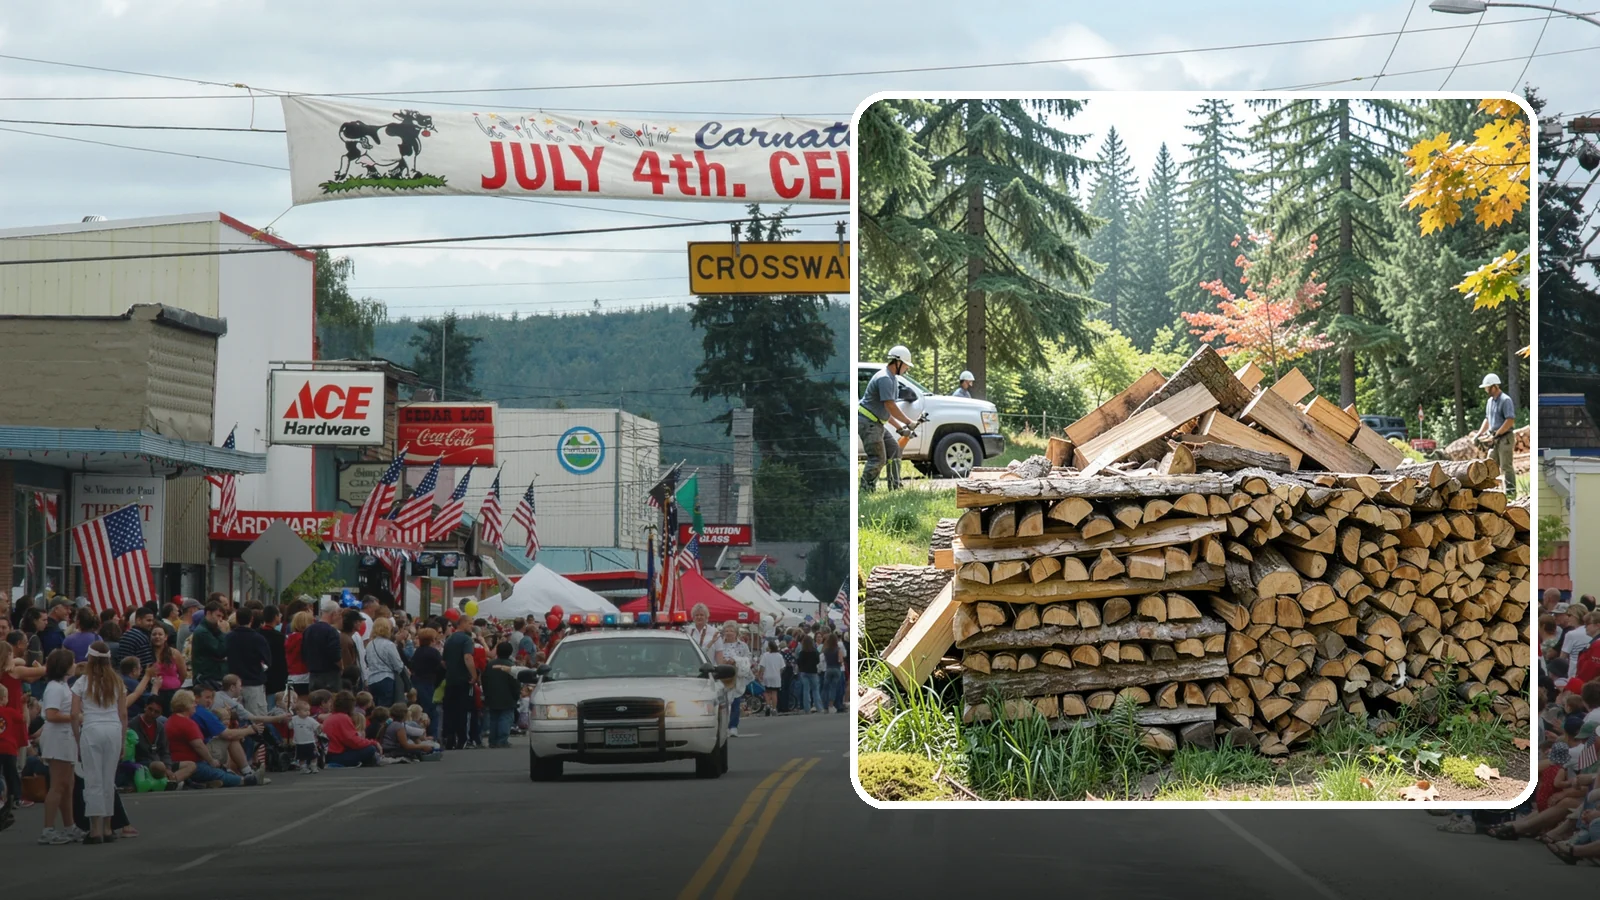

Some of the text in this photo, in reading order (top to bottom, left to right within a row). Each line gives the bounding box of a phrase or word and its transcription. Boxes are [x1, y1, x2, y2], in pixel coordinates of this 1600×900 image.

[481, 140, 605, 191] JULY
[632, 149, 746, 197] 4th.
[697, 254, 850, 280] CROSSWA
[283, 380, 374, 420] ACE
[405, 409, 453, 422] CEDAR
[284, 421, 370, 436] Hardware
[95, 485, 124, 495] Vincent
[126, 486, 134, 495] de
[137, 486, 155, 495] Paul
[688, 526, 741, 535] CRNATION
[699, 535, 730, 543] GLASS
